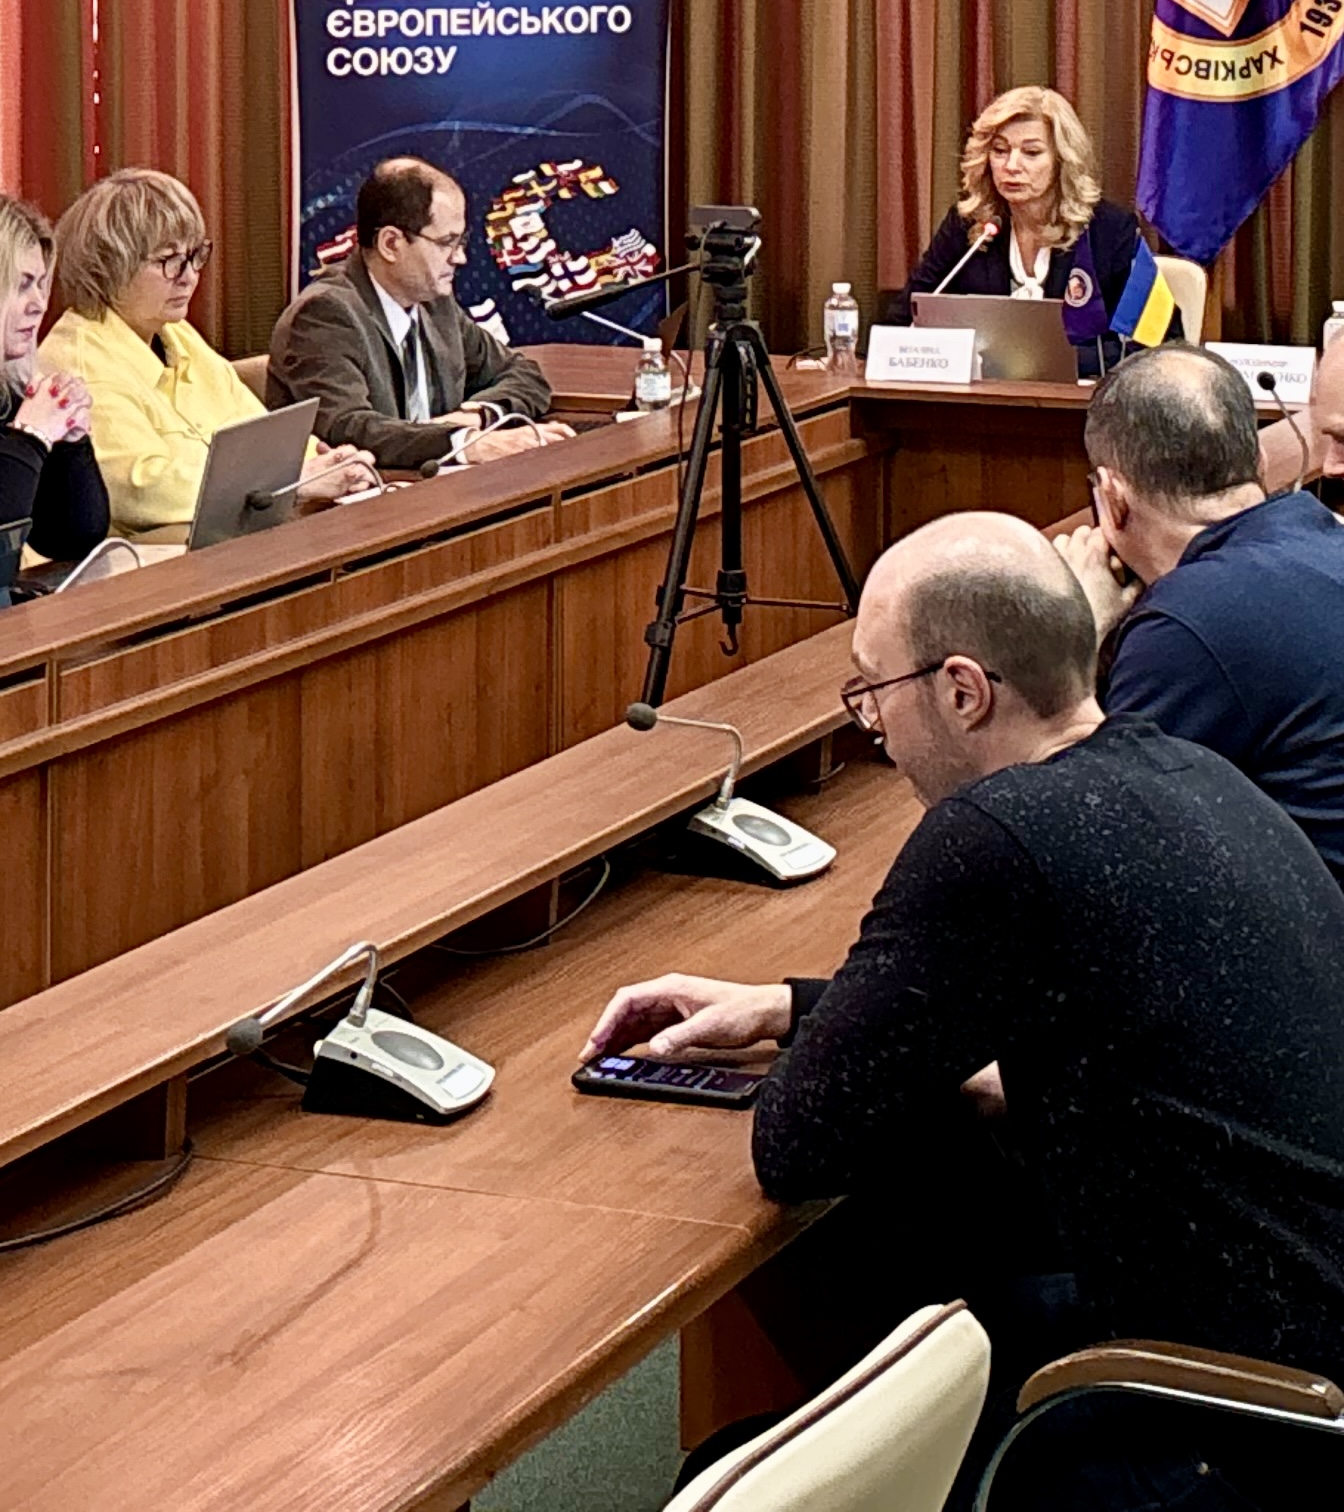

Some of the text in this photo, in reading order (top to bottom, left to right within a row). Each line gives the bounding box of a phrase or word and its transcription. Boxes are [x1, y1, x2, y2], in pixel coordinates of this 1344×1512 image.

[327, 1, 632, 38] ЄВРОПЕЙСЬКОГО
[327, 46, 457, 76] СОЮЗУ
[888, 356, 949, 369] БАБЕНКО
